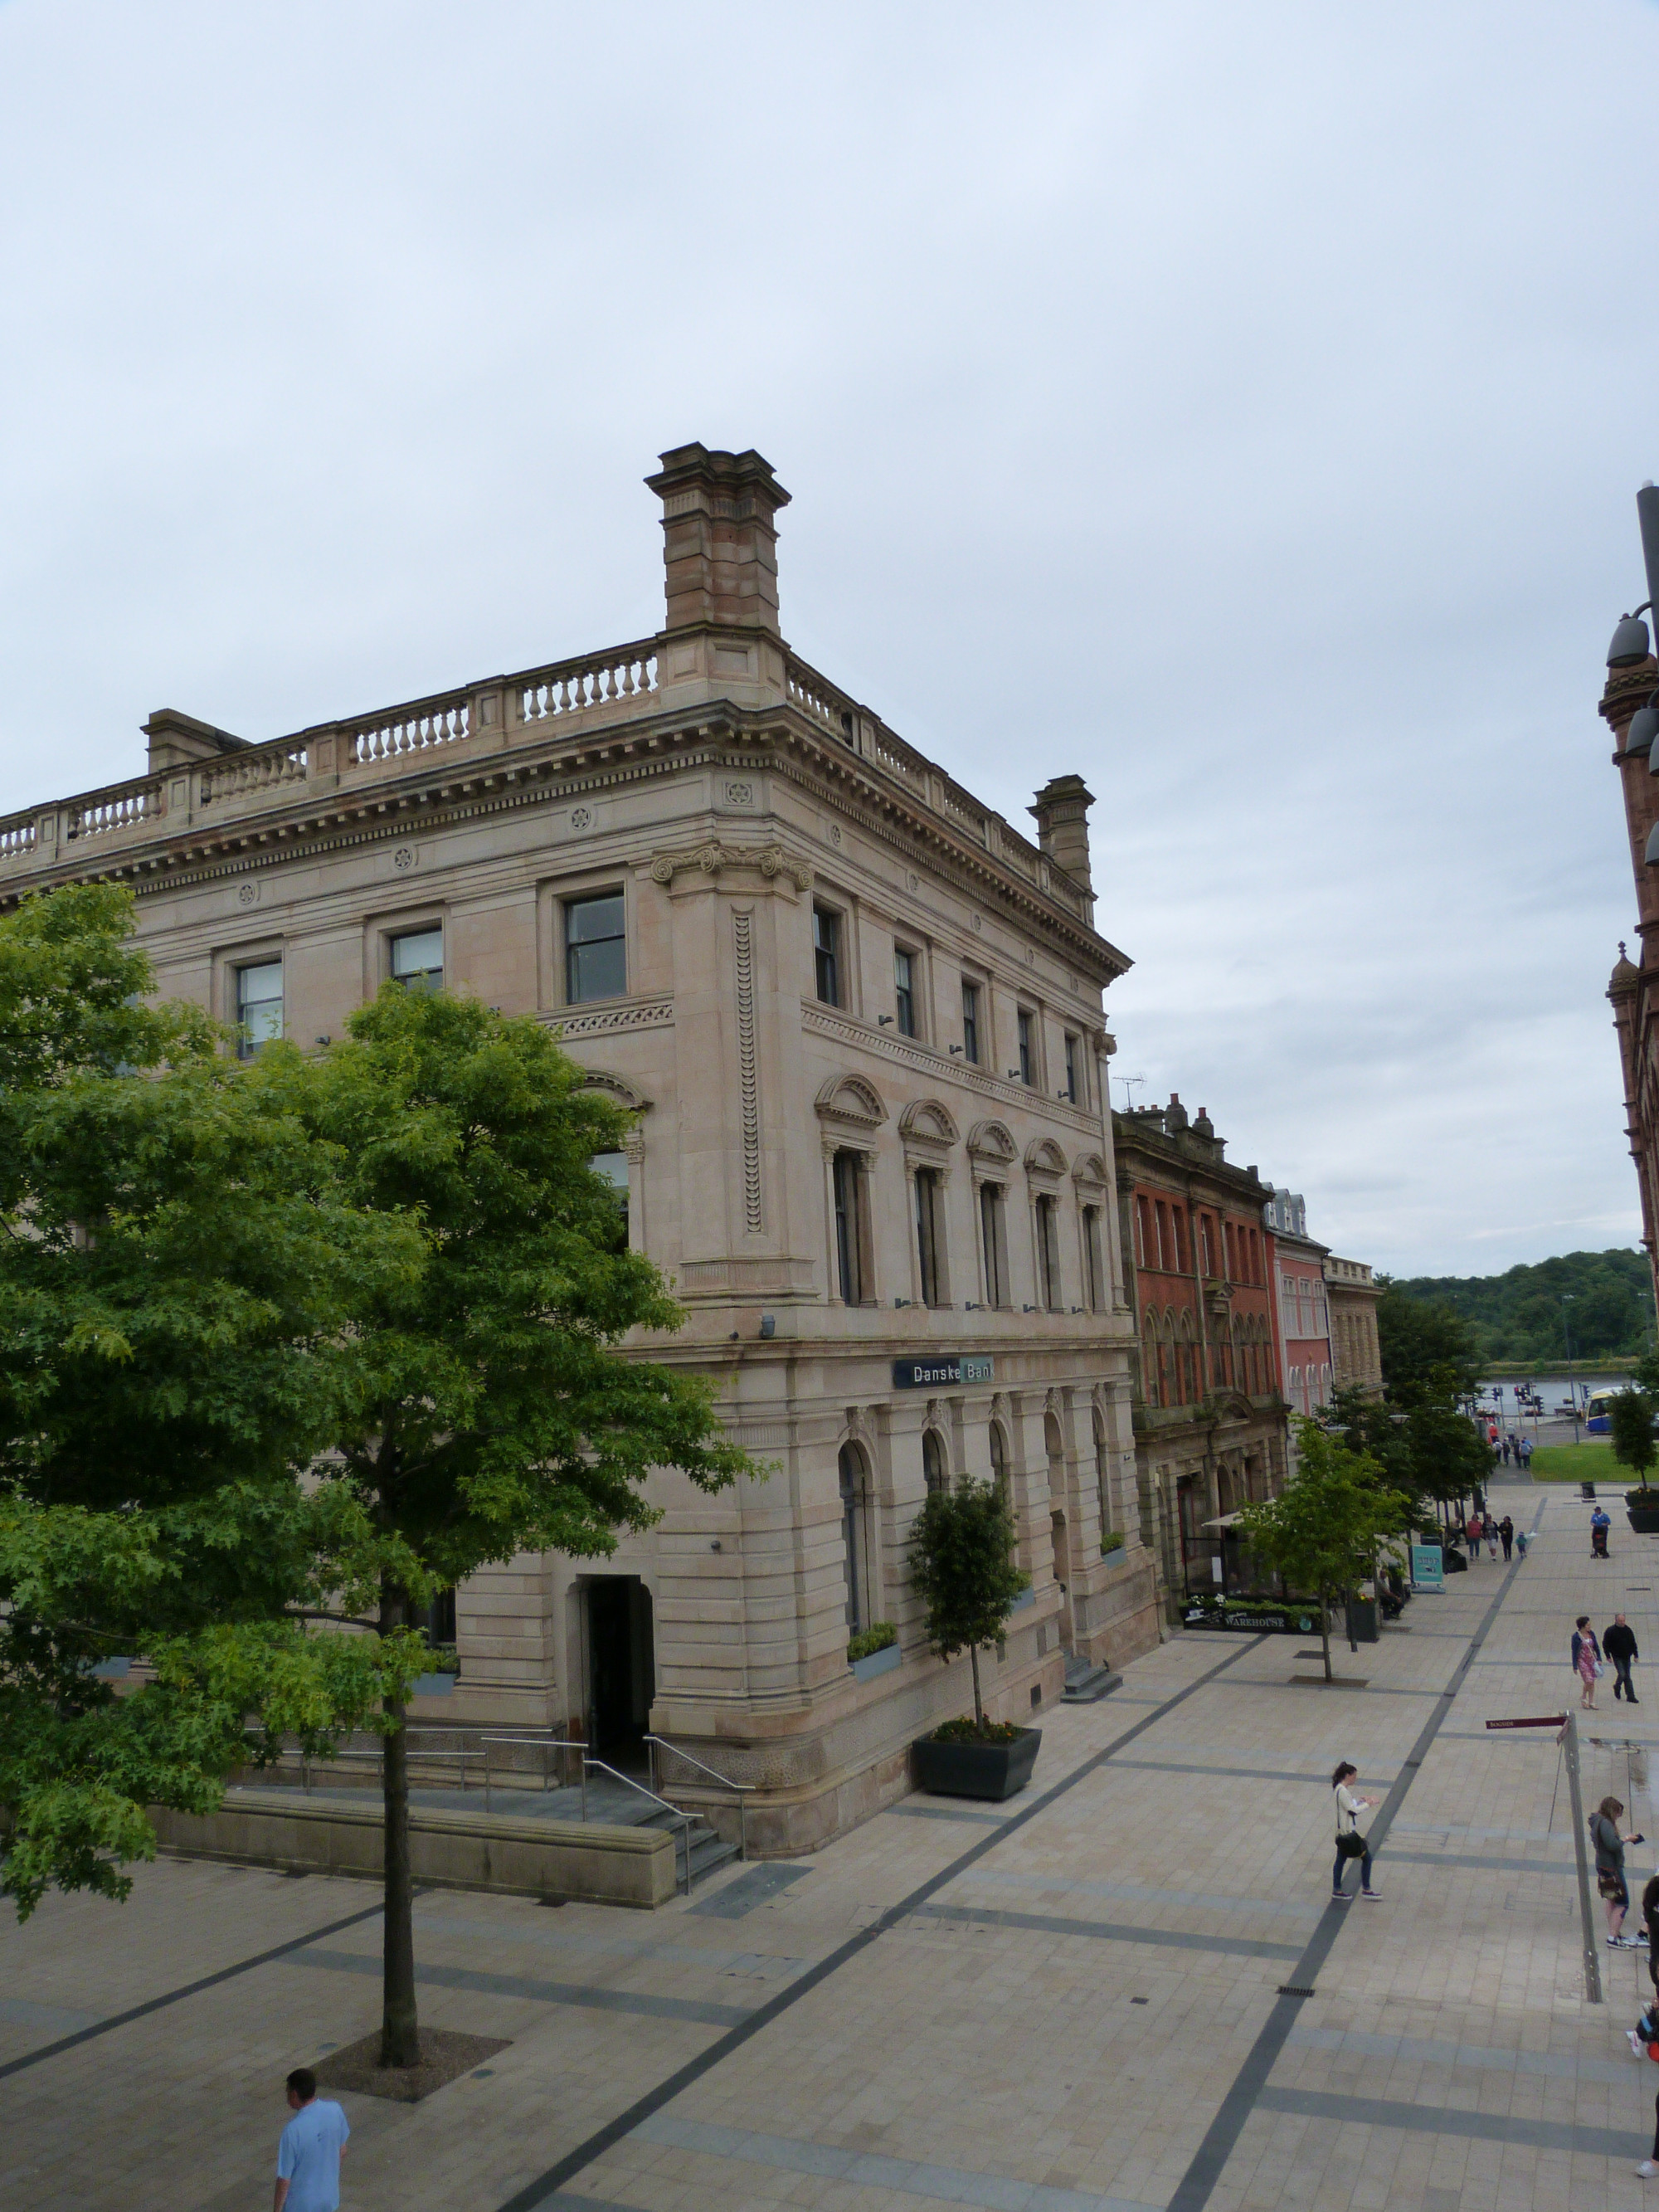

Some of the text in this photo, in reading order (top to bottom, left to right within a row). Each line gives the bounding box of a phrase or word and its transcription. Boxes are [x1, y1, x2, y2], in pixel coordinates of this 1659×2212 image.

[914, 1363, 995, 1382] Danske Bank
[1225, 1617, 1285, 1628] WAREHOUSE
